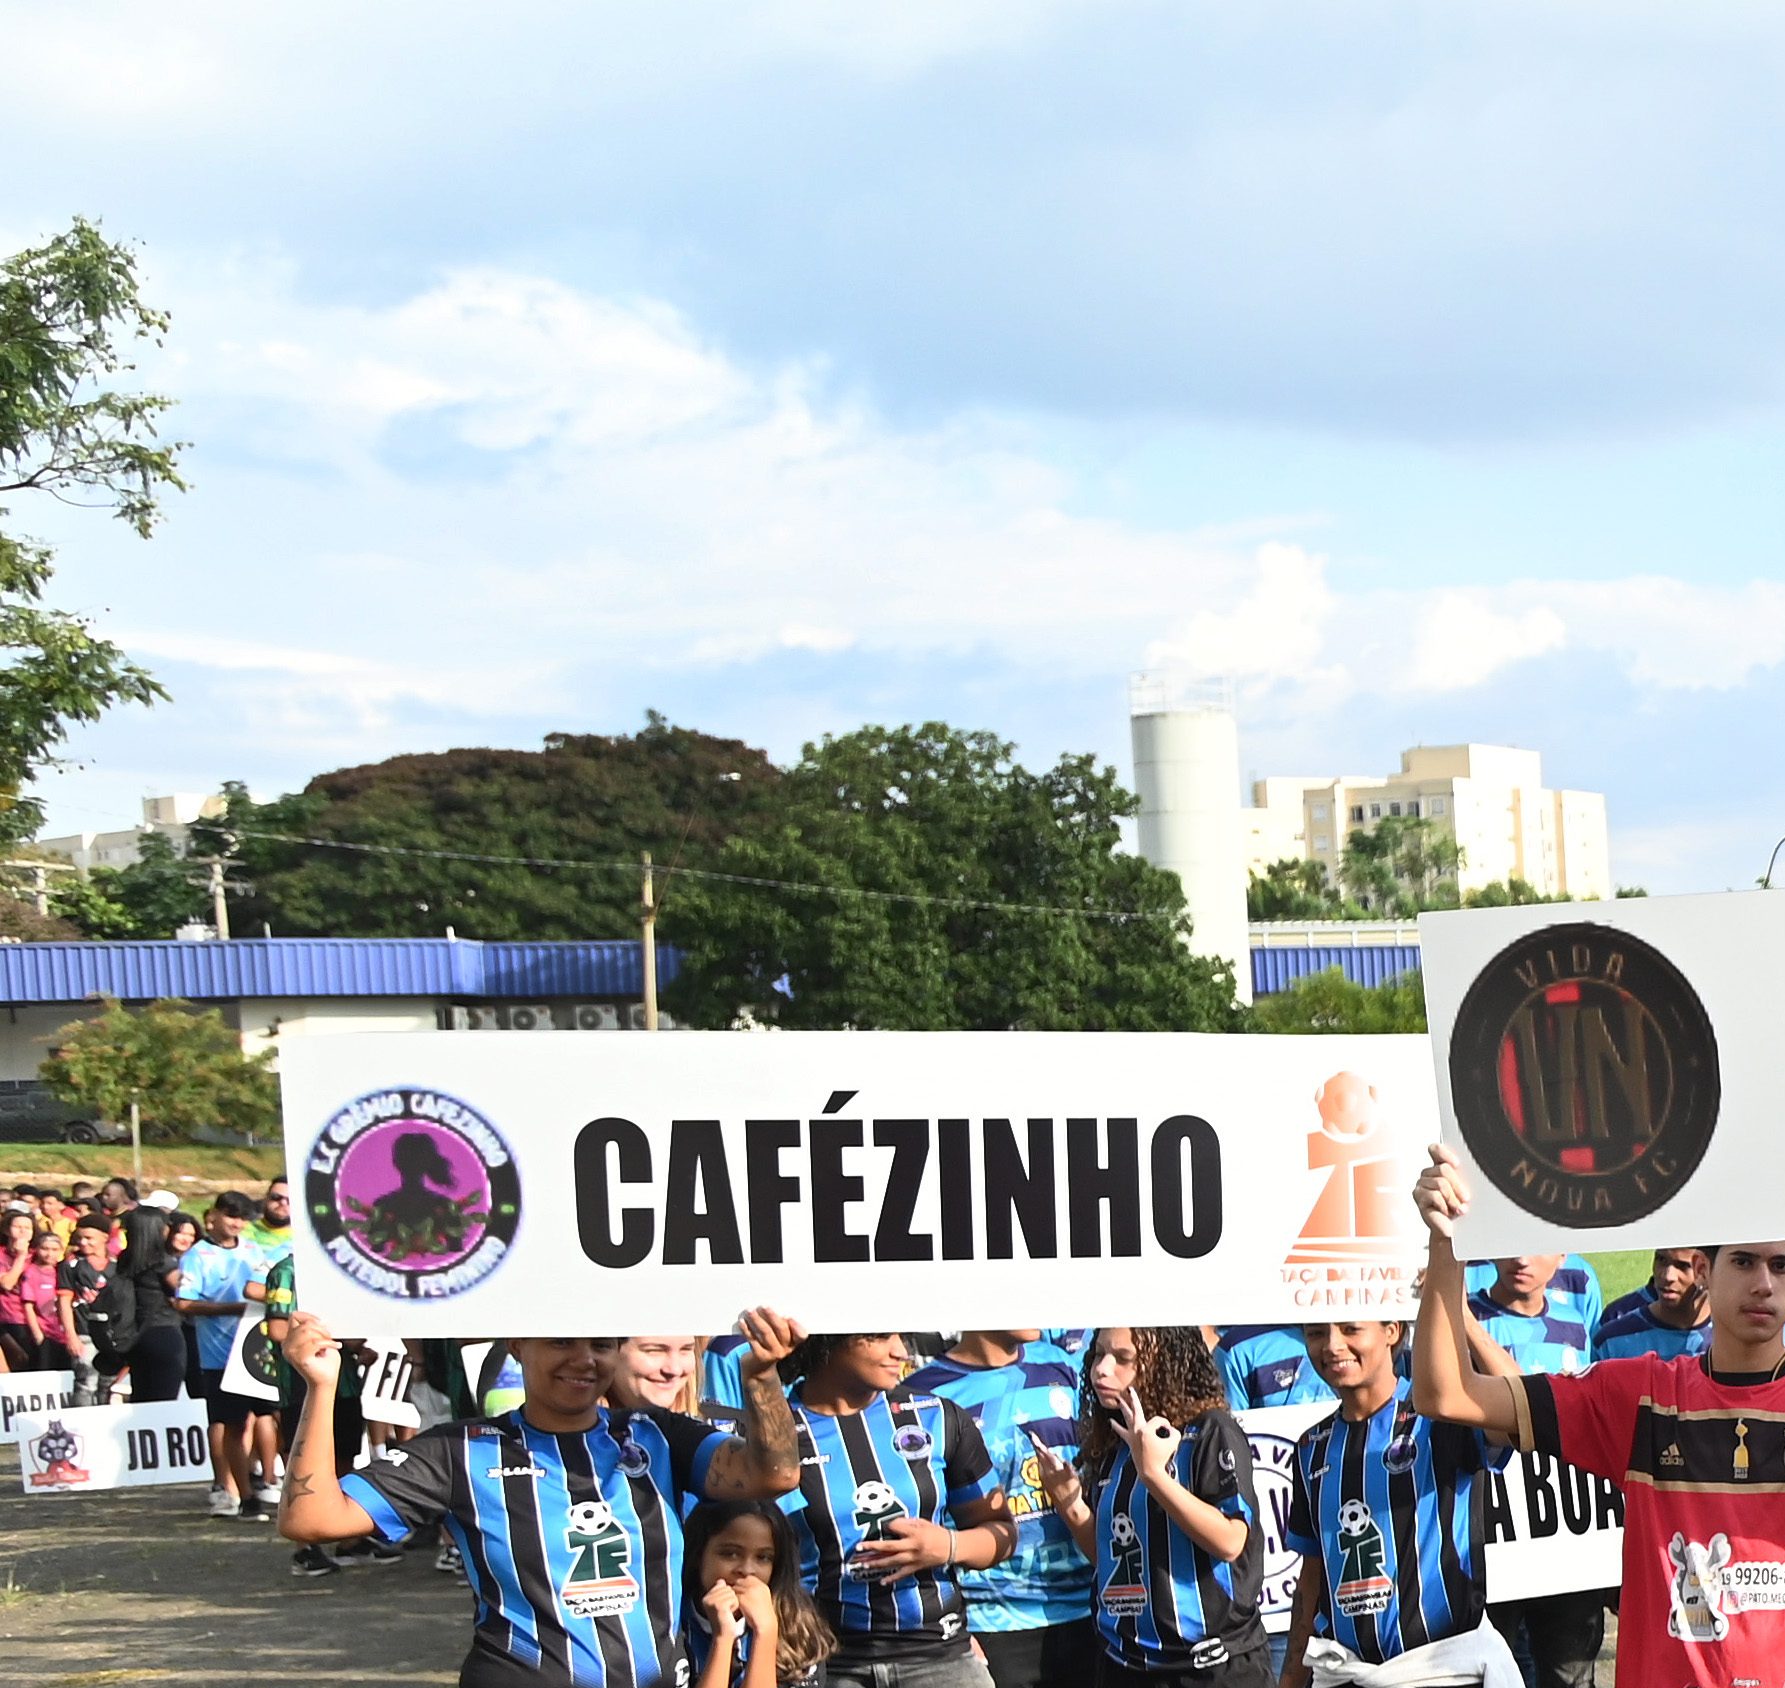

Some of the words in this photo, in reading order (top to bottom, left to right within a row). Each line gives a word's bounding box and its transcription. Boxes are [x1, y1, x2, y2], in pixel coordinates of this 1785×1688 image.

[1513, 944, 1624, 990] VIDA
[574, 1089, 1223, 1269] CAFÉZINHO
[1511, 1156, 1613, 1211] NOVA
[1632, 1149, 1677, 1195] FC
[127, 1428, 160, 1471] JD
[1721, 1572, 1731, 1586] 19
